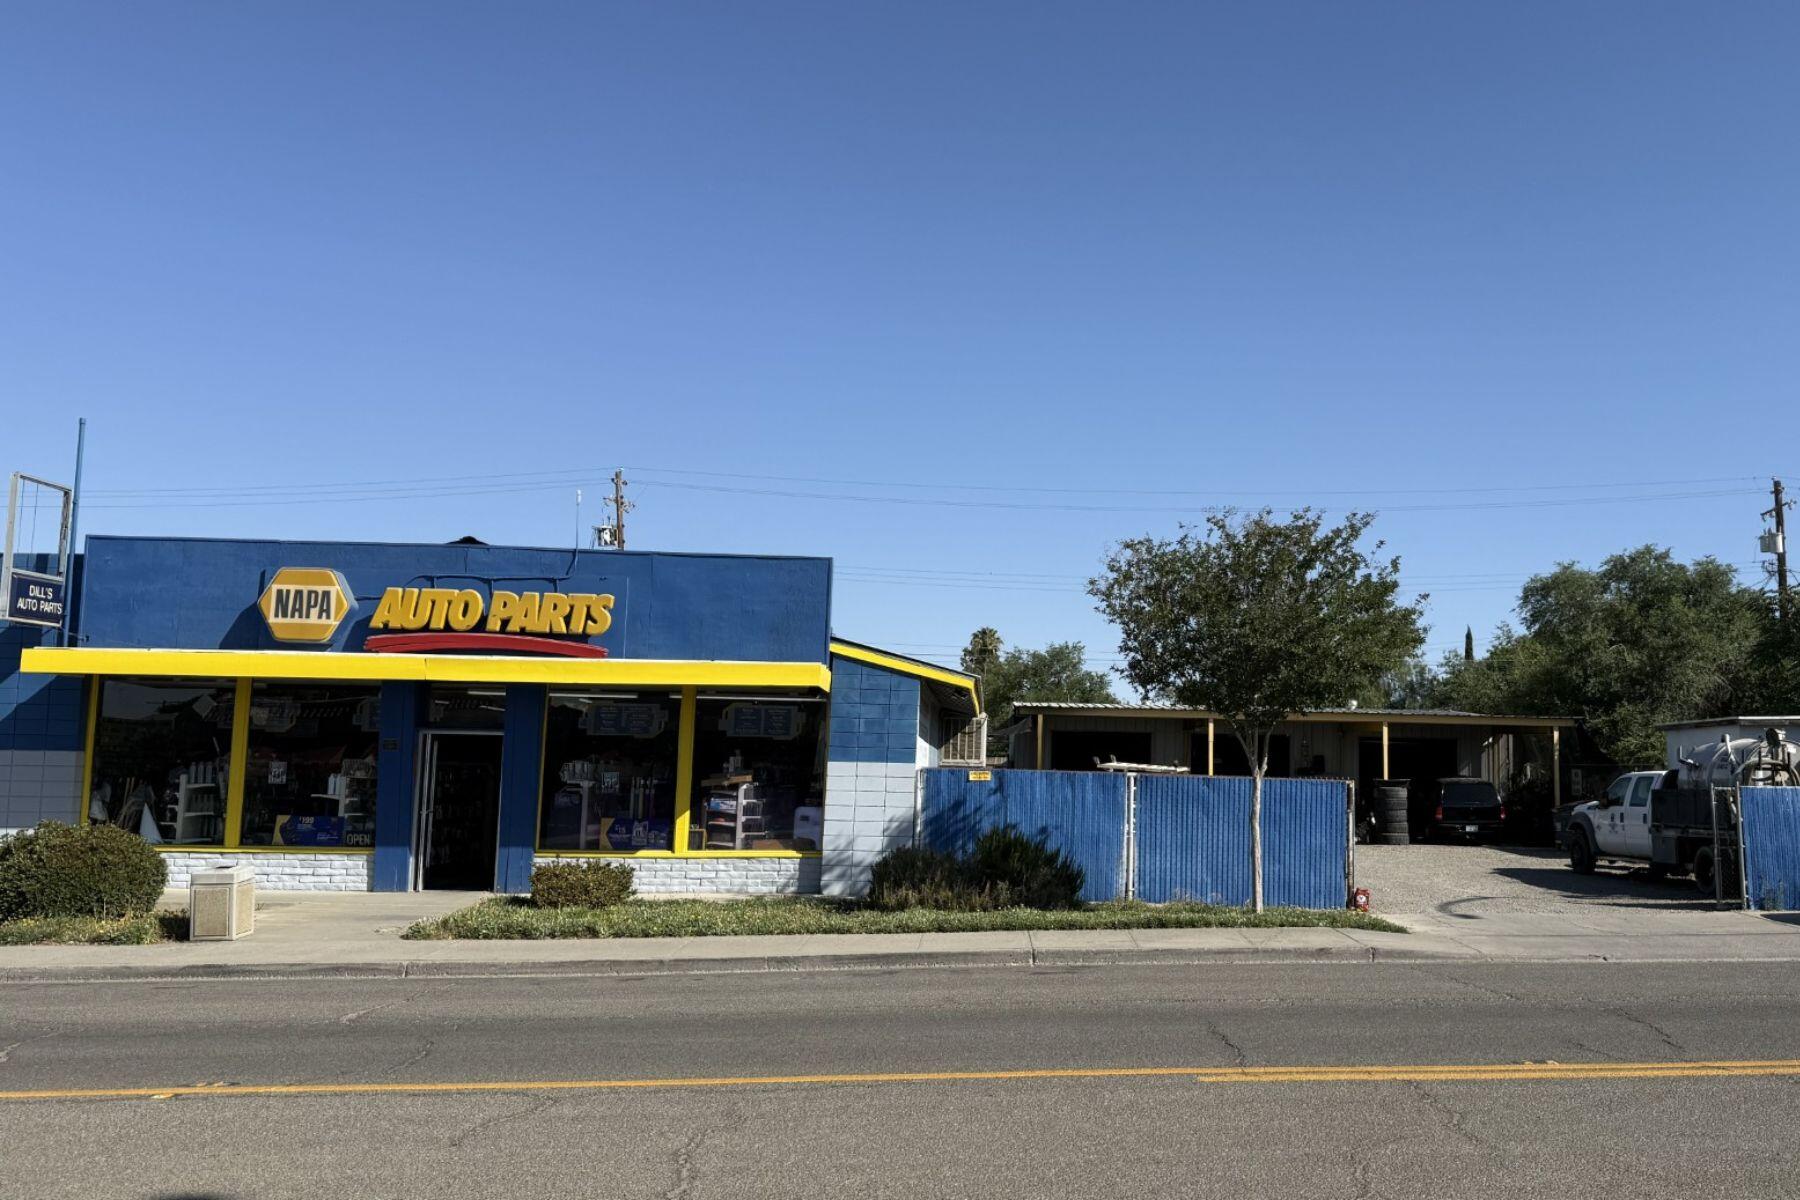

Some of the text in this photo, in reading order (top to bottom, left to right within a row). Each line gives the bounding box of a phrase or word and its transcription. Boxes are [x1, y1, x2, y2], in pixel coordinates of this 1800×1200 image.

[29, 585, 53, 599] DILL'S
[17, 597, 63, 614] AUTO PARTS
[273, 588, 332, 620] NAPA
[369, 587, 614, 635] AUTO PARTS
[346, 833, 371, 845] OPEN
